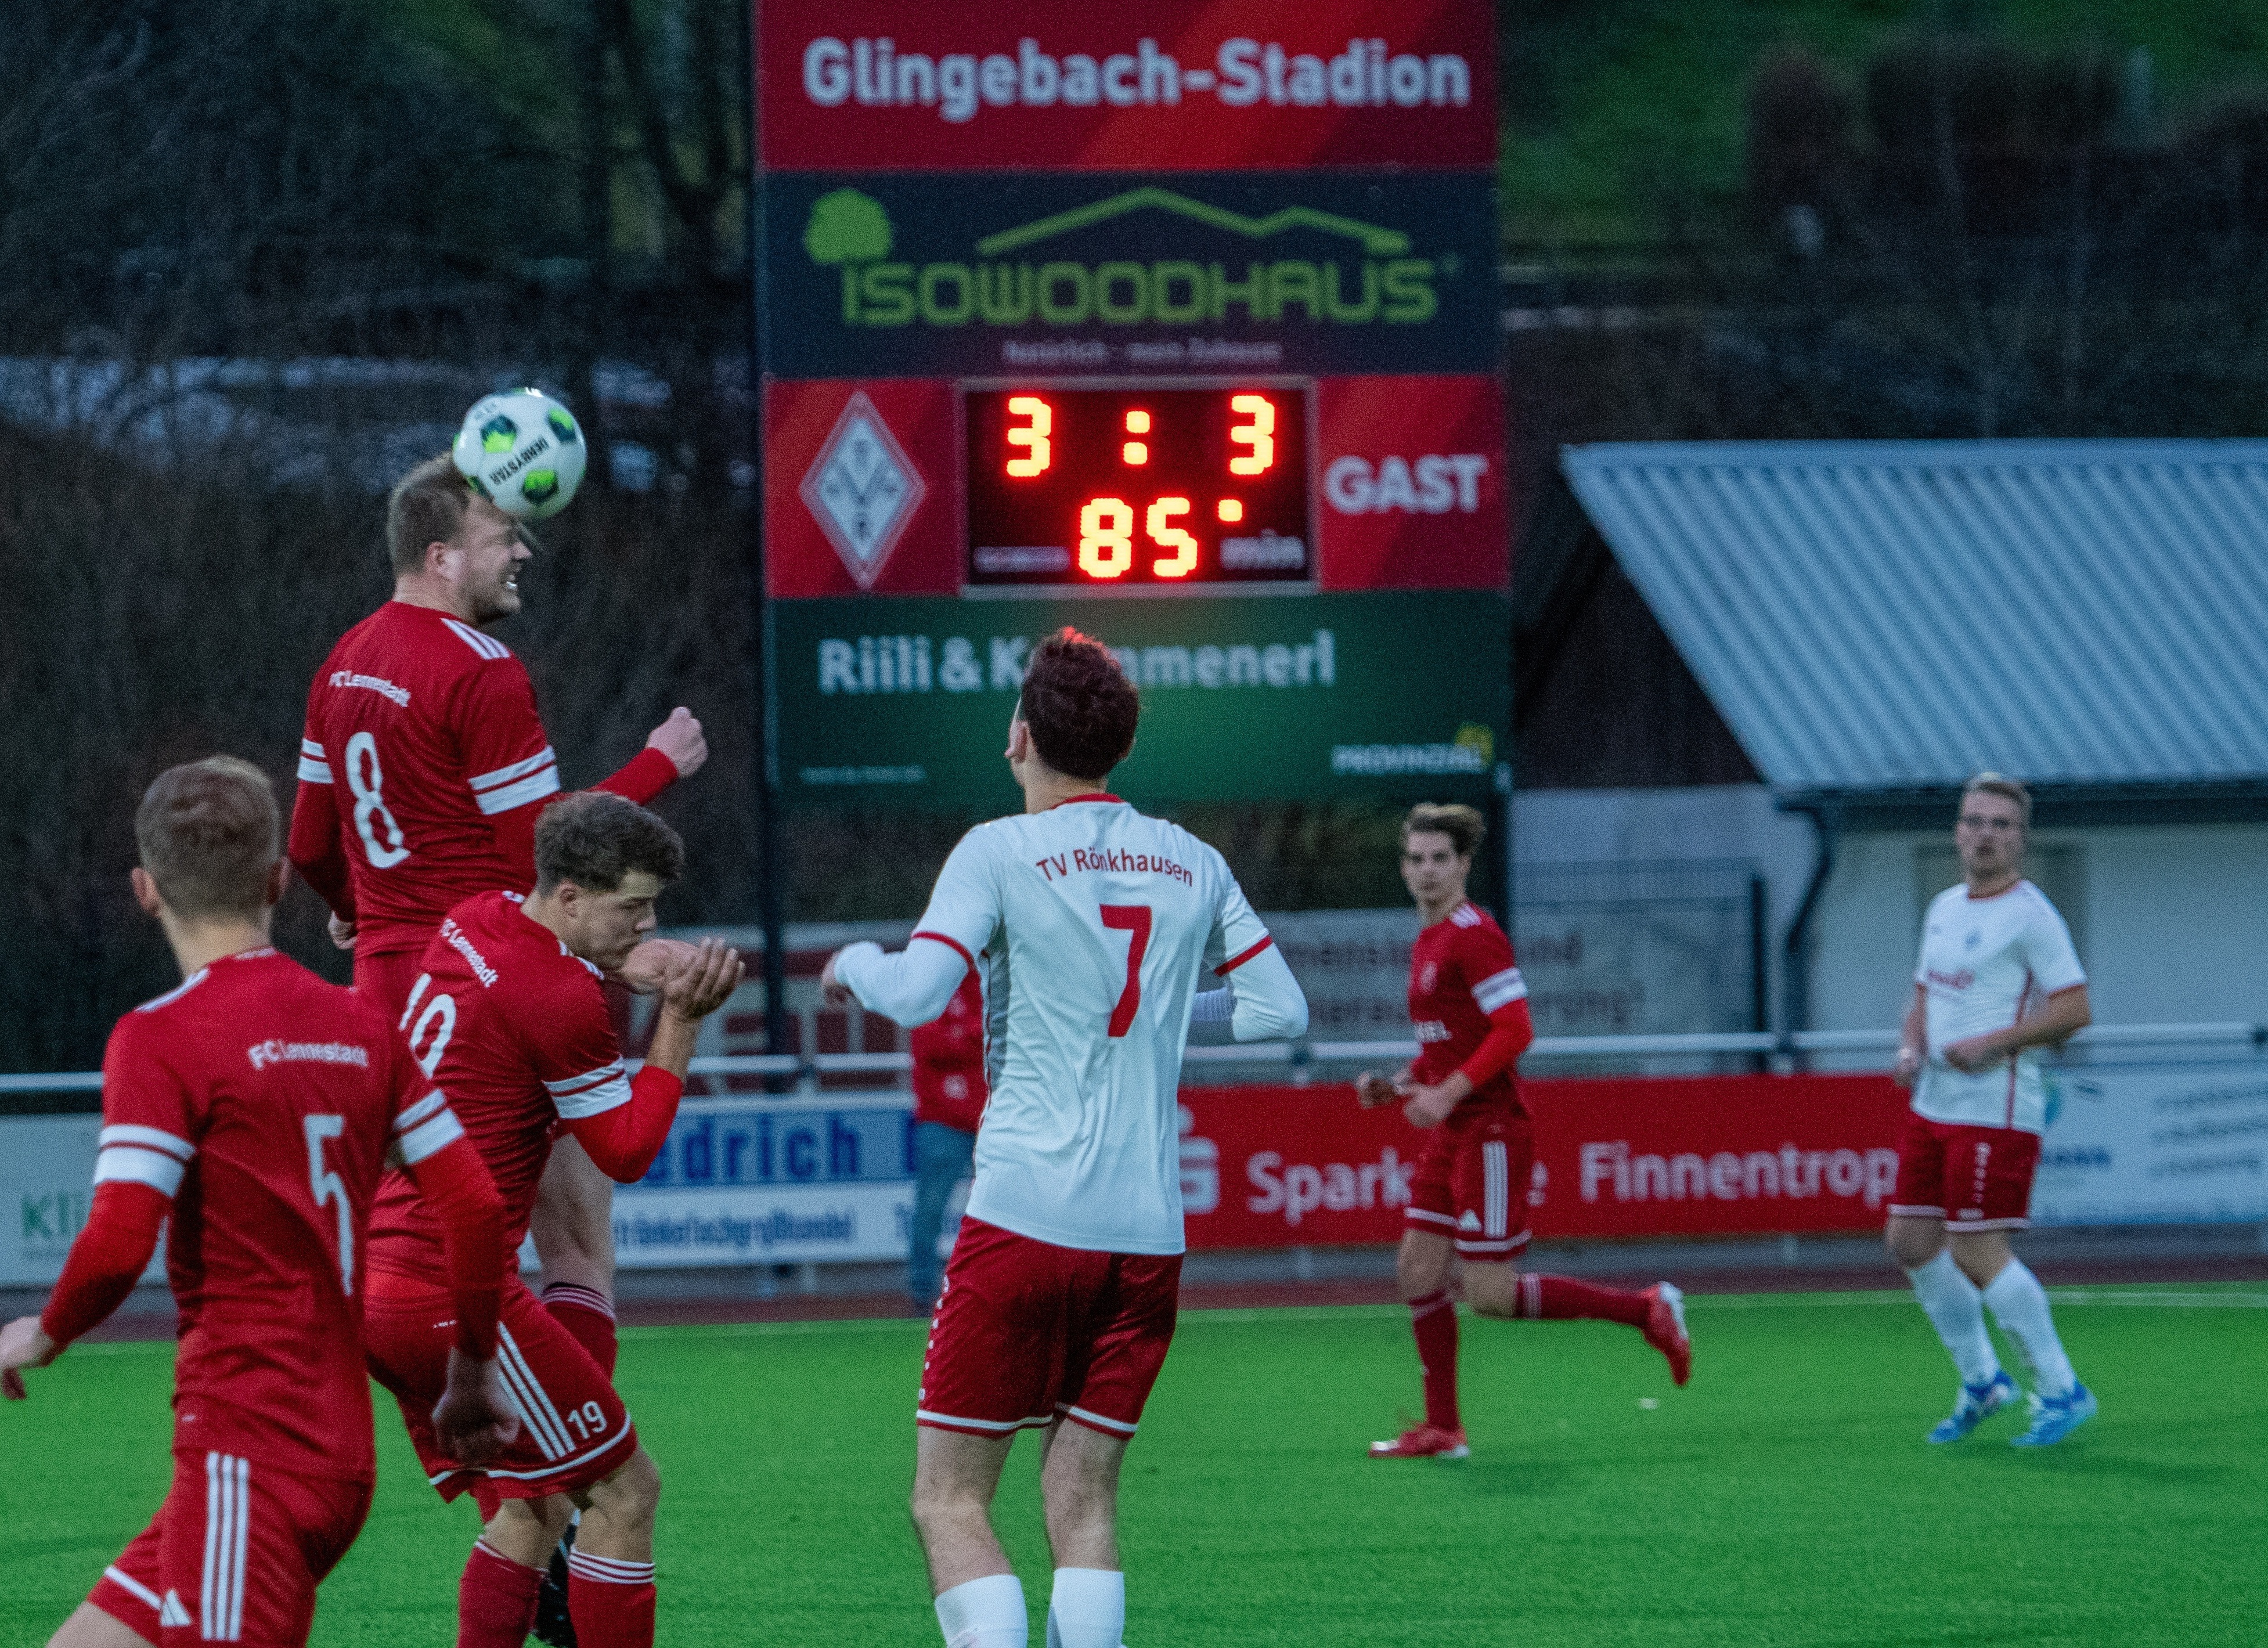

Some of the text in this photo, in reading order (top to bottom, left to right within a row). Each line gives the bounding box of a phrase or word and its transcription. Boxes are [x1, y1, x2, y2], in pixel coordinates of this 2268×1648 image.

[803, 36, 1470, 122] Glingebach-Stadion
[489, 436, 550, 486] DERBYSTAR
[1006, 396, 1052, 478] 3
[1229, 395, 1275, 475] 3
[1324, 454, 1488, 514] GAST
[939, 637, 983, 693] &
[345, 731, 410, 869] 8
[1036, 846, 1192, 887] TV Rönkhausen
[1099, 903, 1153, 1038] 7
[304, 1115, 354, 1296] 5
[1580, 1140, 1899, 1209] Finnentrop
[567, 1400, 608, 1440] 19
